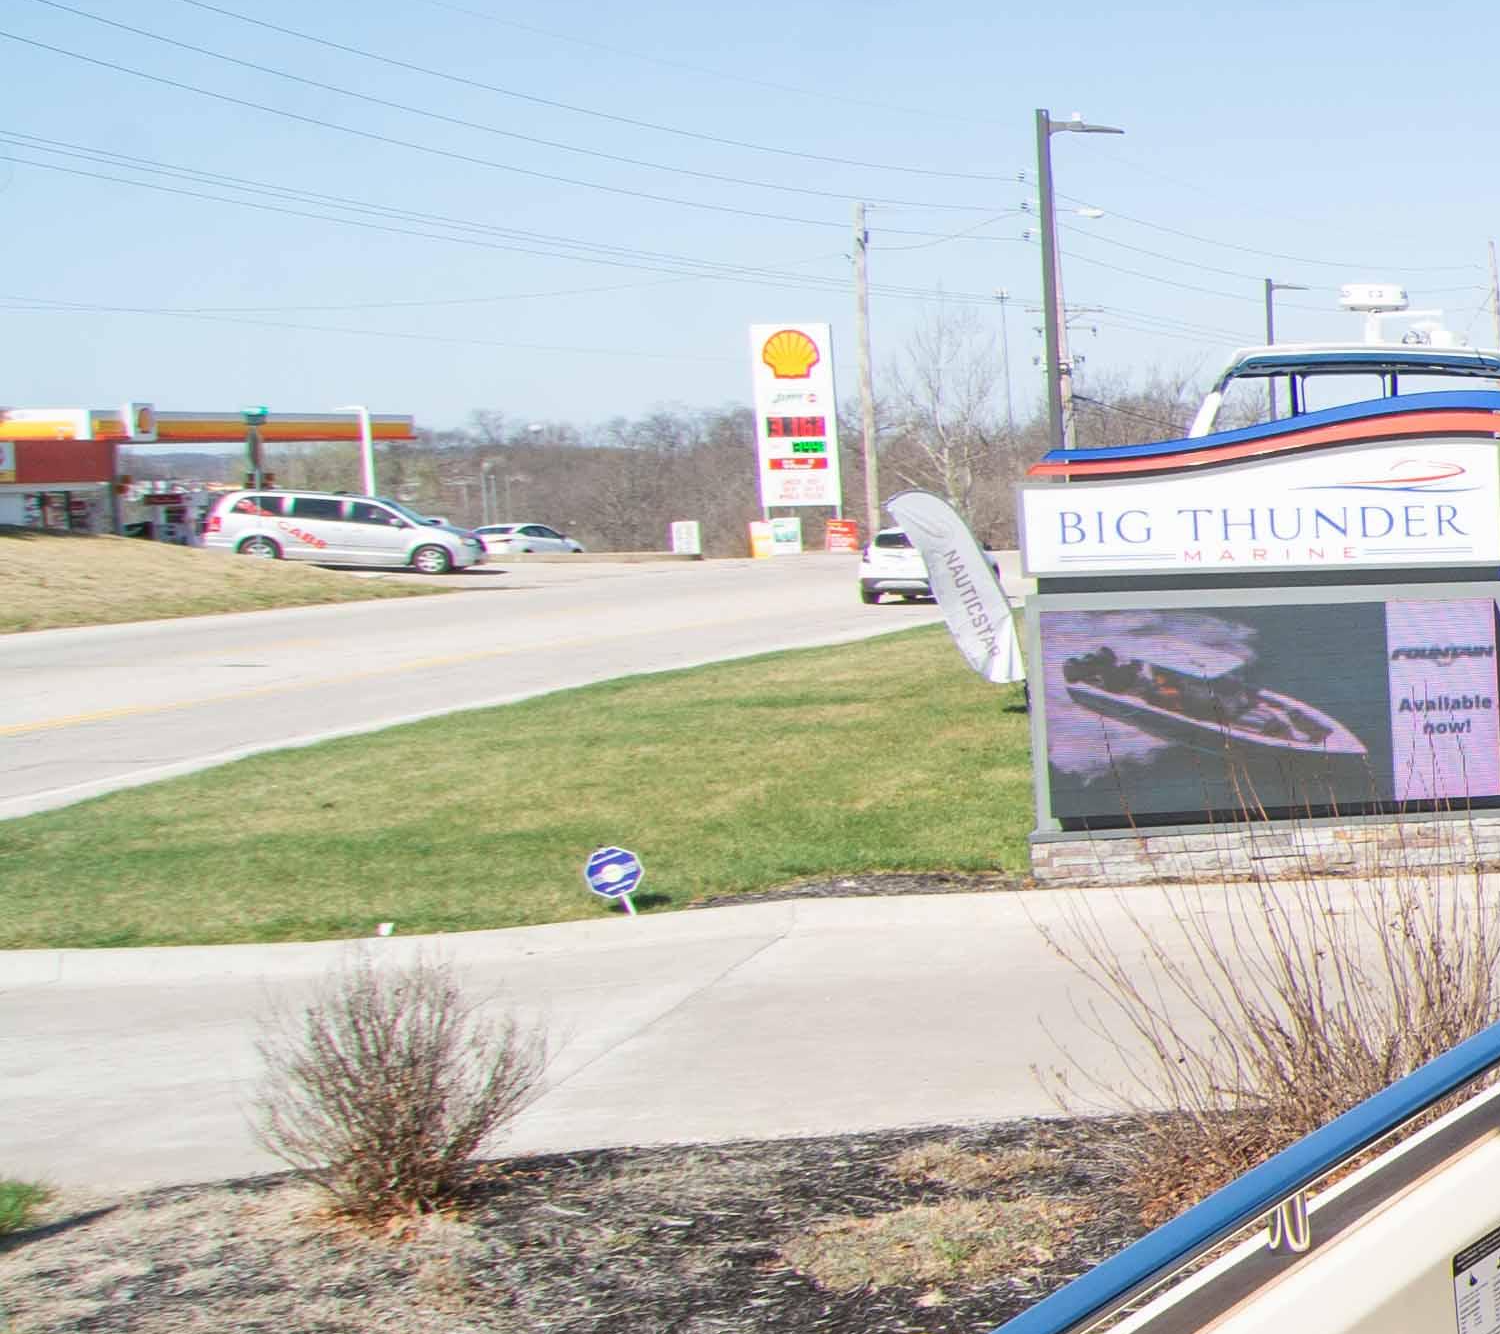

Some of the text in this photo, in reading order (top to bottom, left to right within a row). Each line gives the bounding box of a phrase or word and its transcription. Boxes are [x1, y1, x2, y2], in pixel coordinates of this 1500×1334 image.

[1059, 503, 1470, 546] BIG THUNDER
[1184, 545, 1358, 562] MARINE
[1398, 695, 1493, 713] Available
[1423, 718, 1472, 734] now!
